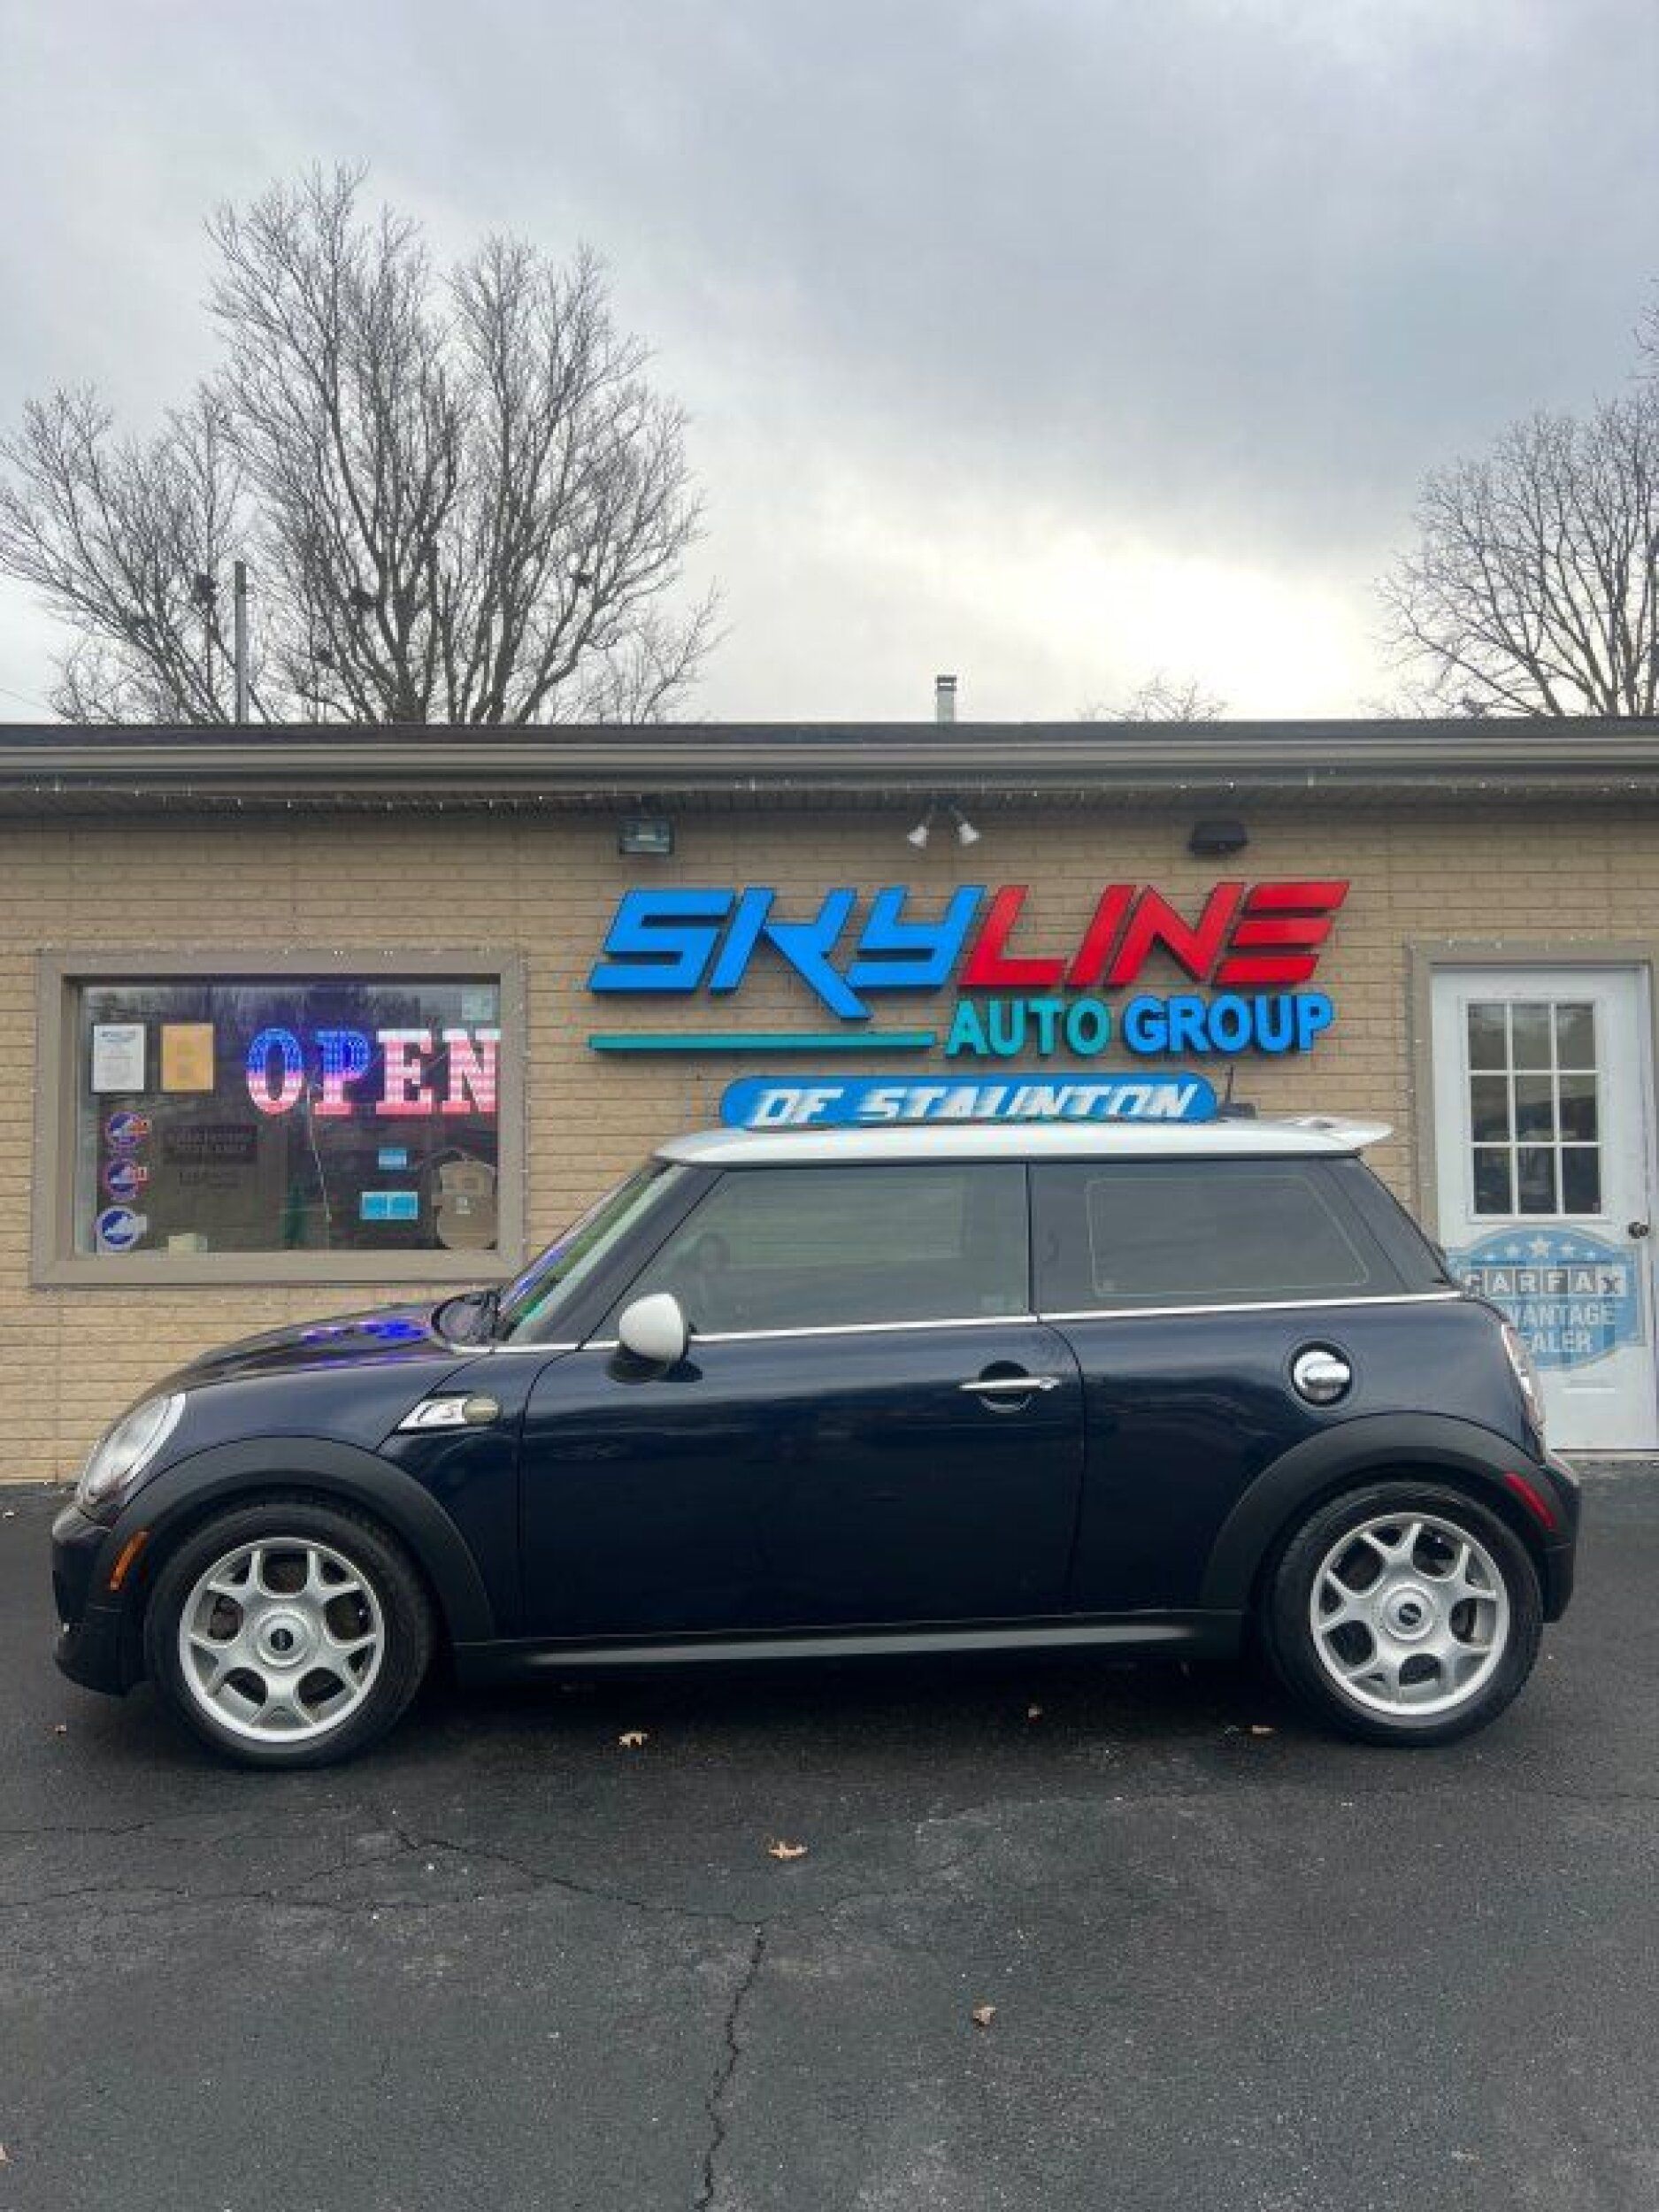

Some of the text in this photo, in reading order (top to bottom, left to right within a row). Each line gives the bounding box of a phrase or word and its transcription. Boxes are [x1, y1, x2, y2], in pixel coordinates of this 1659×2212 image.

[587, 880, 1351, 1022] SKYLINE
[944, 992, 1334, 1056] AUTO GROUP
[245, 1027, 502, 1116] OPEN
[748, 1083, 1198, 1126] OF STAUNTON
[1501, 1303, 1616, 1325] VANTAGE
